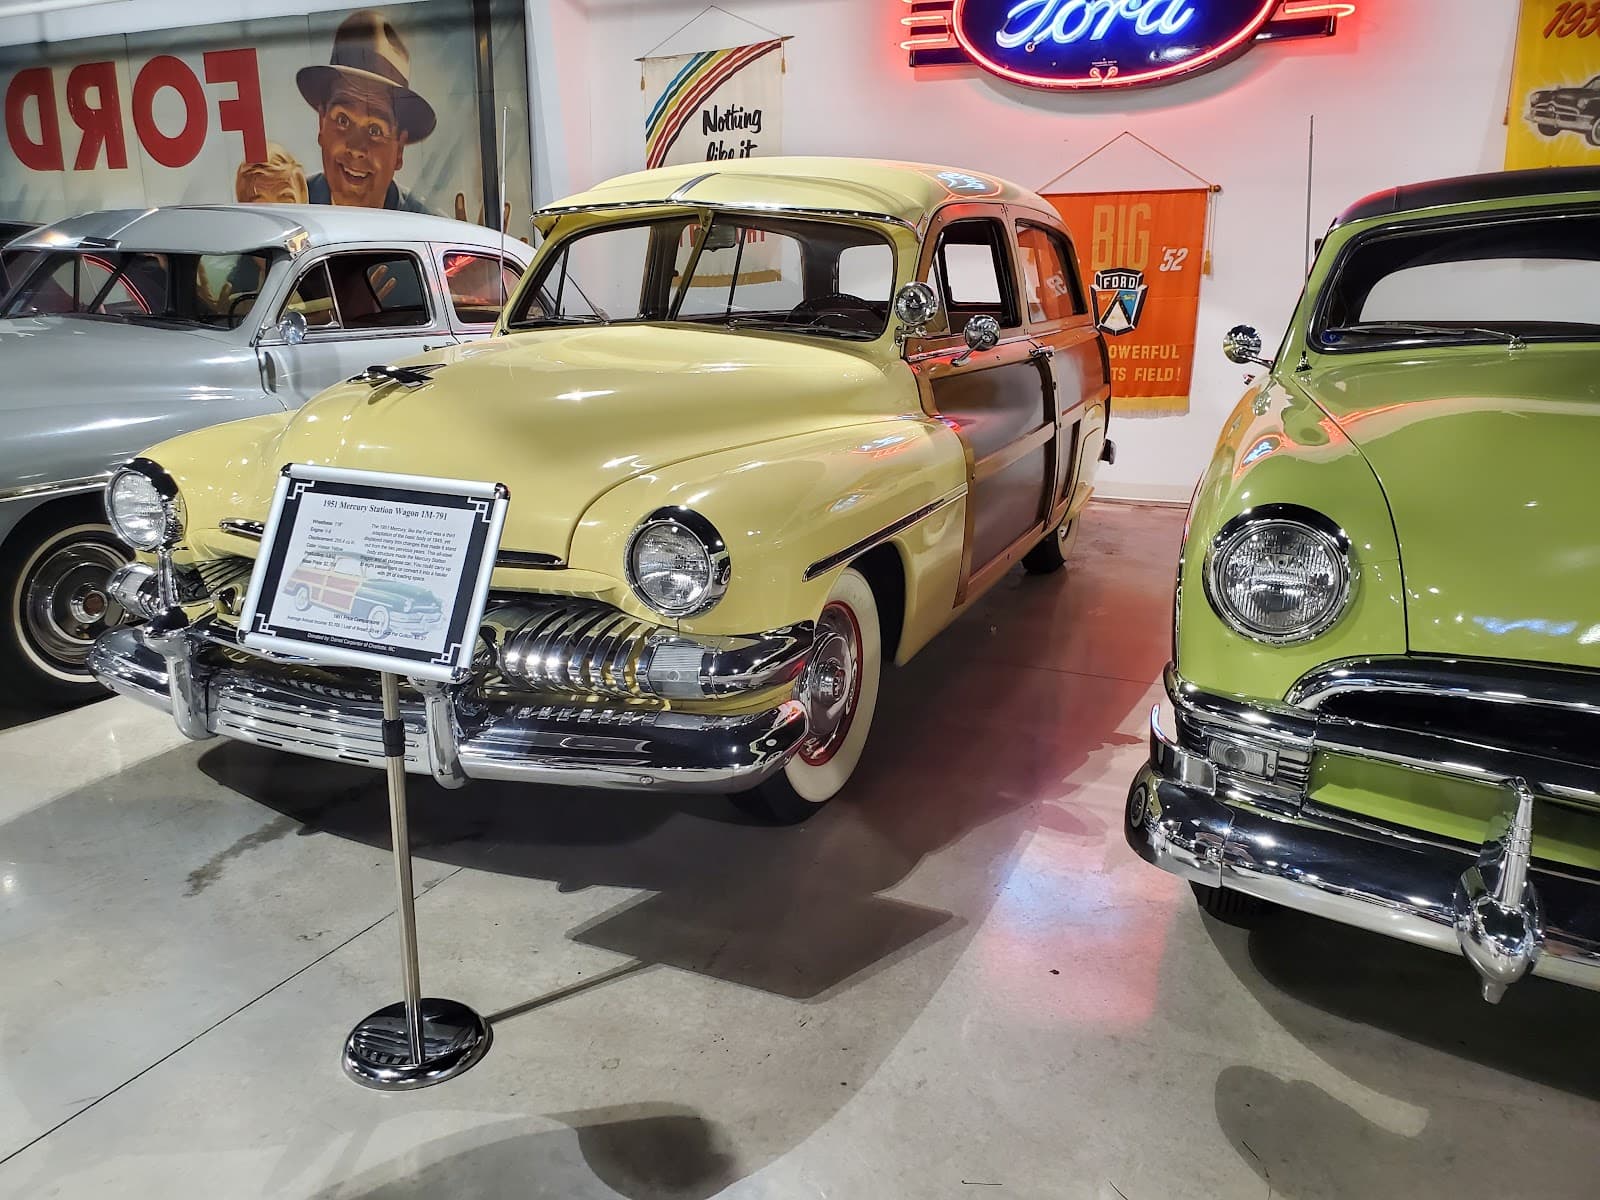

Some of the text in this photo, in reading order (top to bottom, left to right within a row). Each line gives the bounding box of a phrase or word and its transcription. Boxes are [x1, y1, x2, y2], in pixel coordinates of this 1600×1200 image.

[996, 0, 1195, 49] Ford
[1543, 1, 1600, 39] 195
[702, 104, 762, 136] Nothing
[740, 140, 758, 159] it
[1091, 203, 1150, 272] BIG
[1159, 246, 1189, 272] '52
[1103, 276, 1137, 289] FORD
[1109, 344, 1180, 359] OWERFUL
[1112, 367, 1127, 382] TS
[323, 499, 448, 520] 1951 Mercury Station Wagon 1M-791
